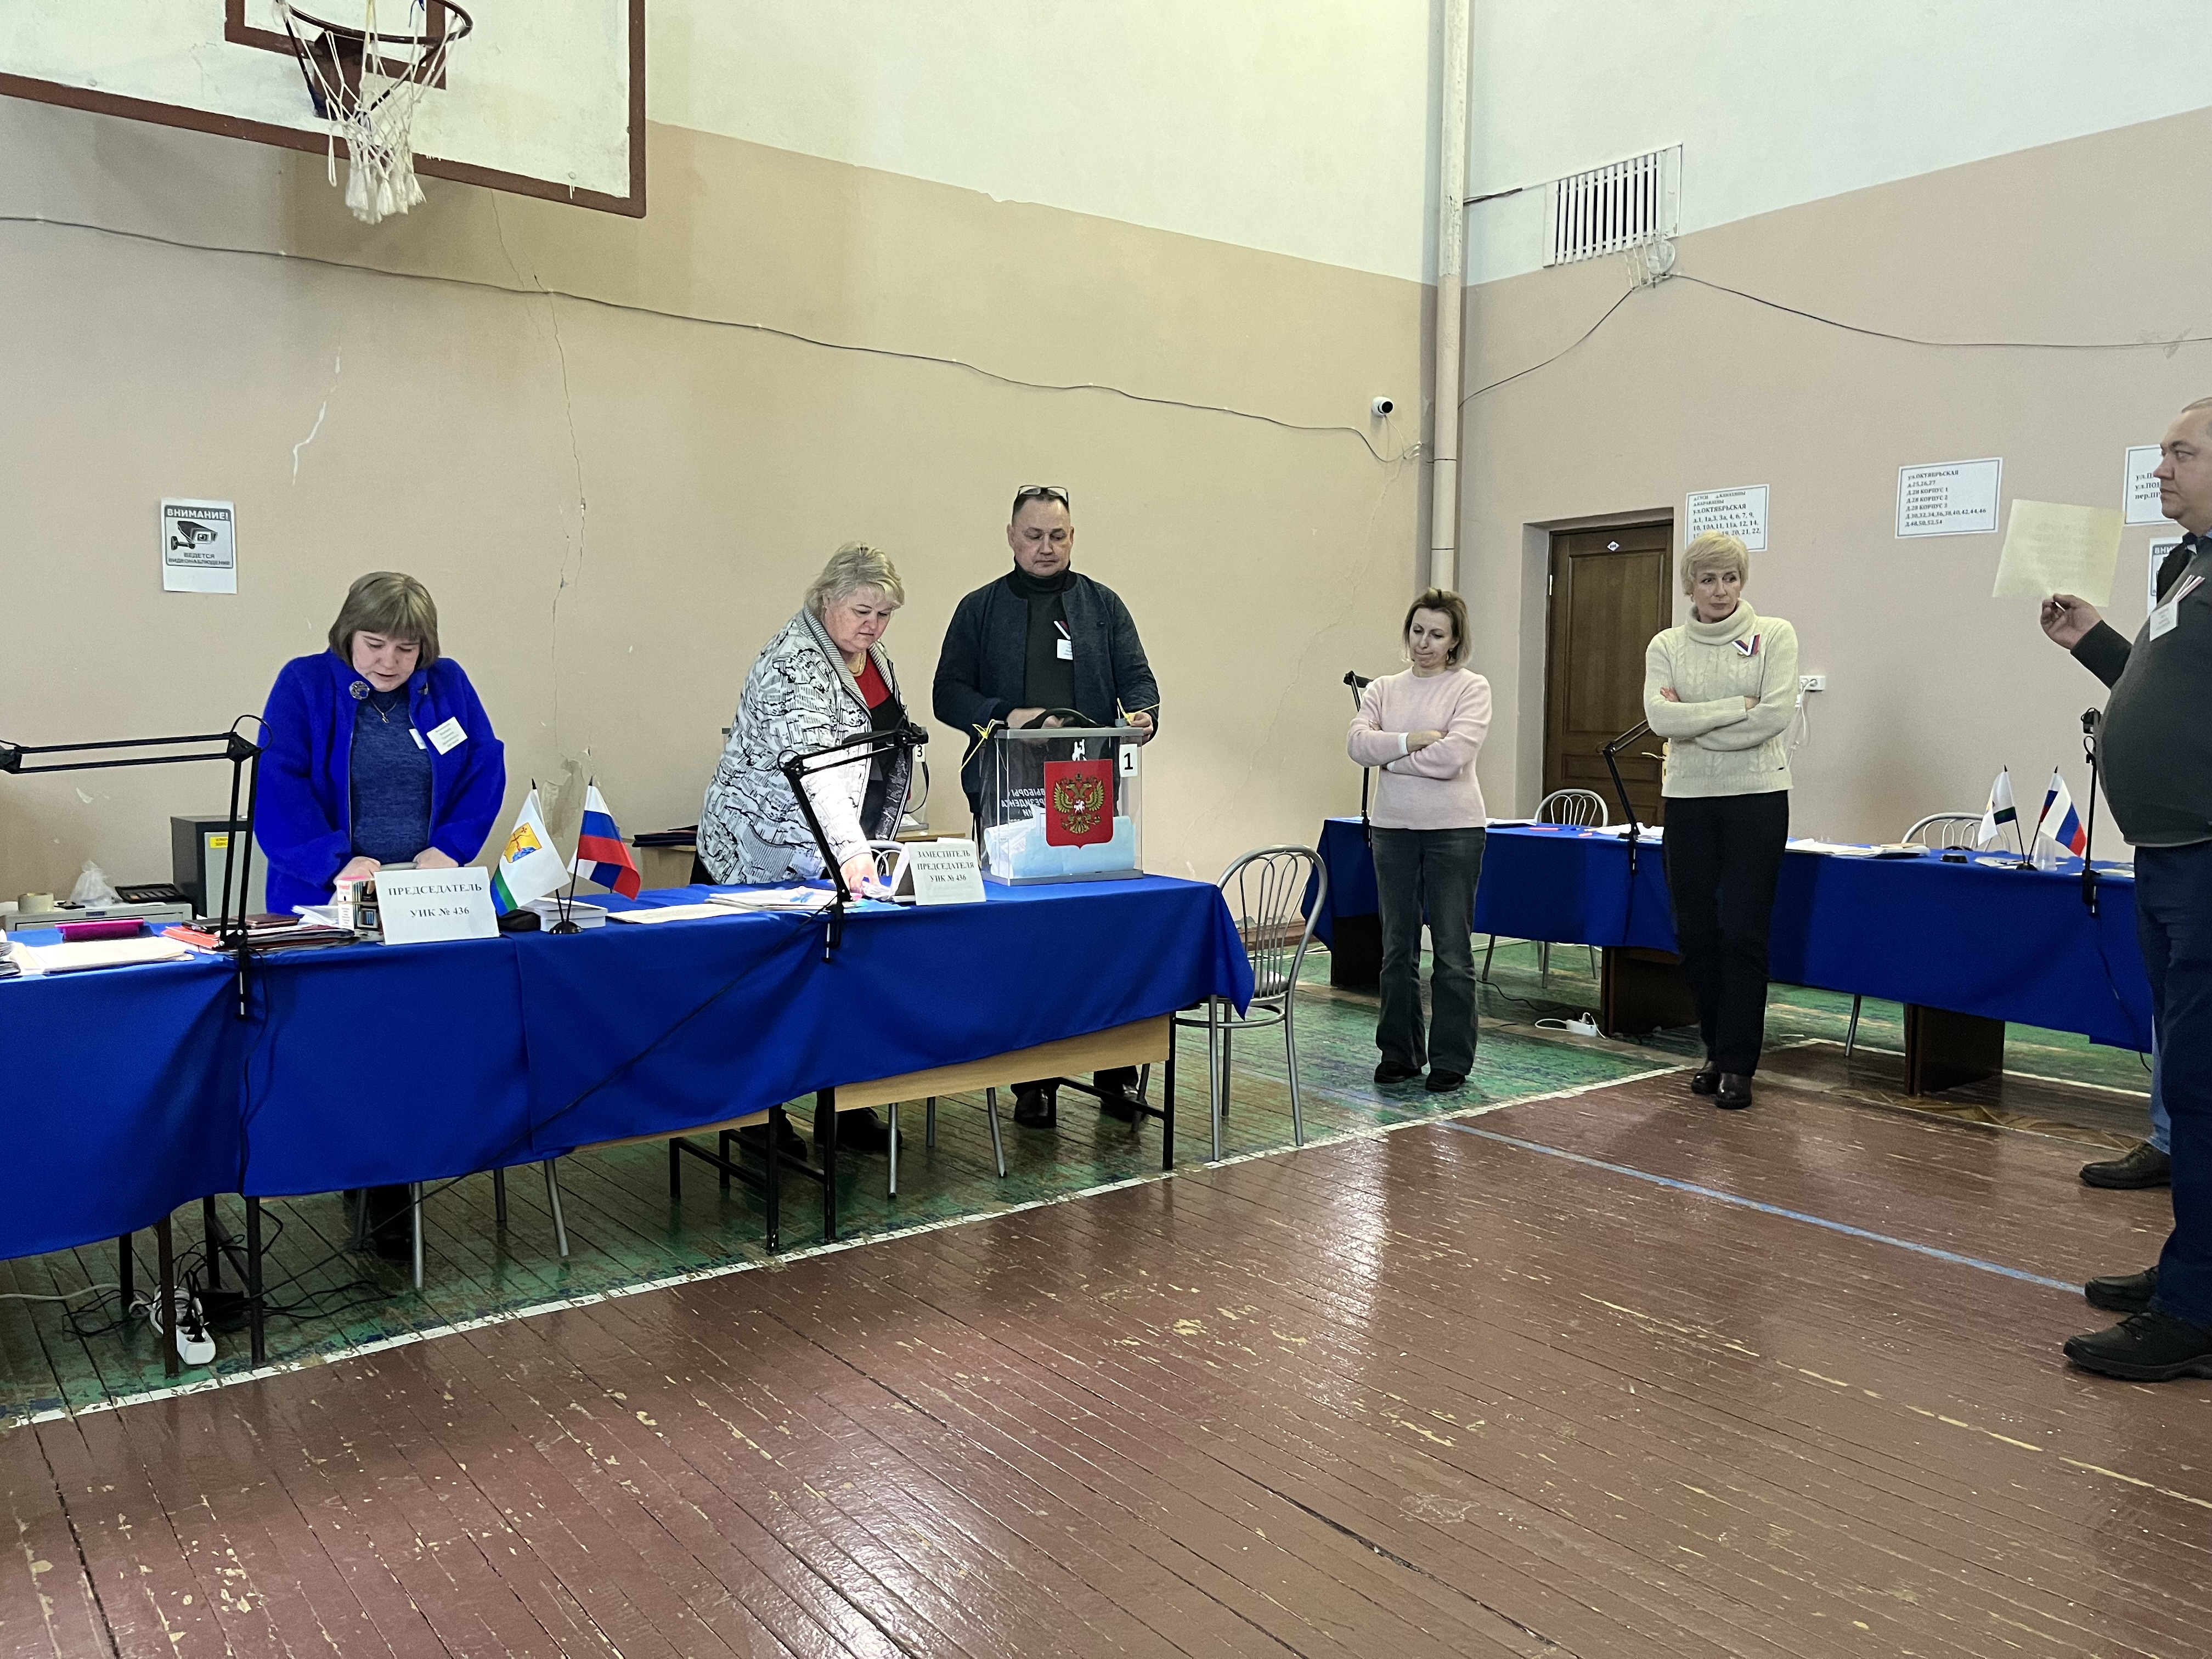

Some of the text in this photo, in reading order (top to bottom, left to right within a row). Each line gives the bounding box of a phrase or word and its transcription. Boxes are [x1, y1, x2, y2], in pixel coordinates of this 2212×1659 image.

[2136, 472, 2154, 482] ул.П
[167, 508, 228, 520] ВНИМАНИЕ!
[1693, 503, 1746, 516] ул.ОКТЯБРЬСКАЯ
[917, 745, 923, 757] 3
[1123, 752, 1134, 770] 1
[917, 850, 970, 858] ЗАМЕСТИТЕЛЬ
[917, 862, 974, 871] ПРЕДСЕДАТЕЛЯ
[388, 883, 482, 896] ПРЕДСЕДАТЕЛЬ
[410, 906, 470, 918] УИК № 436
